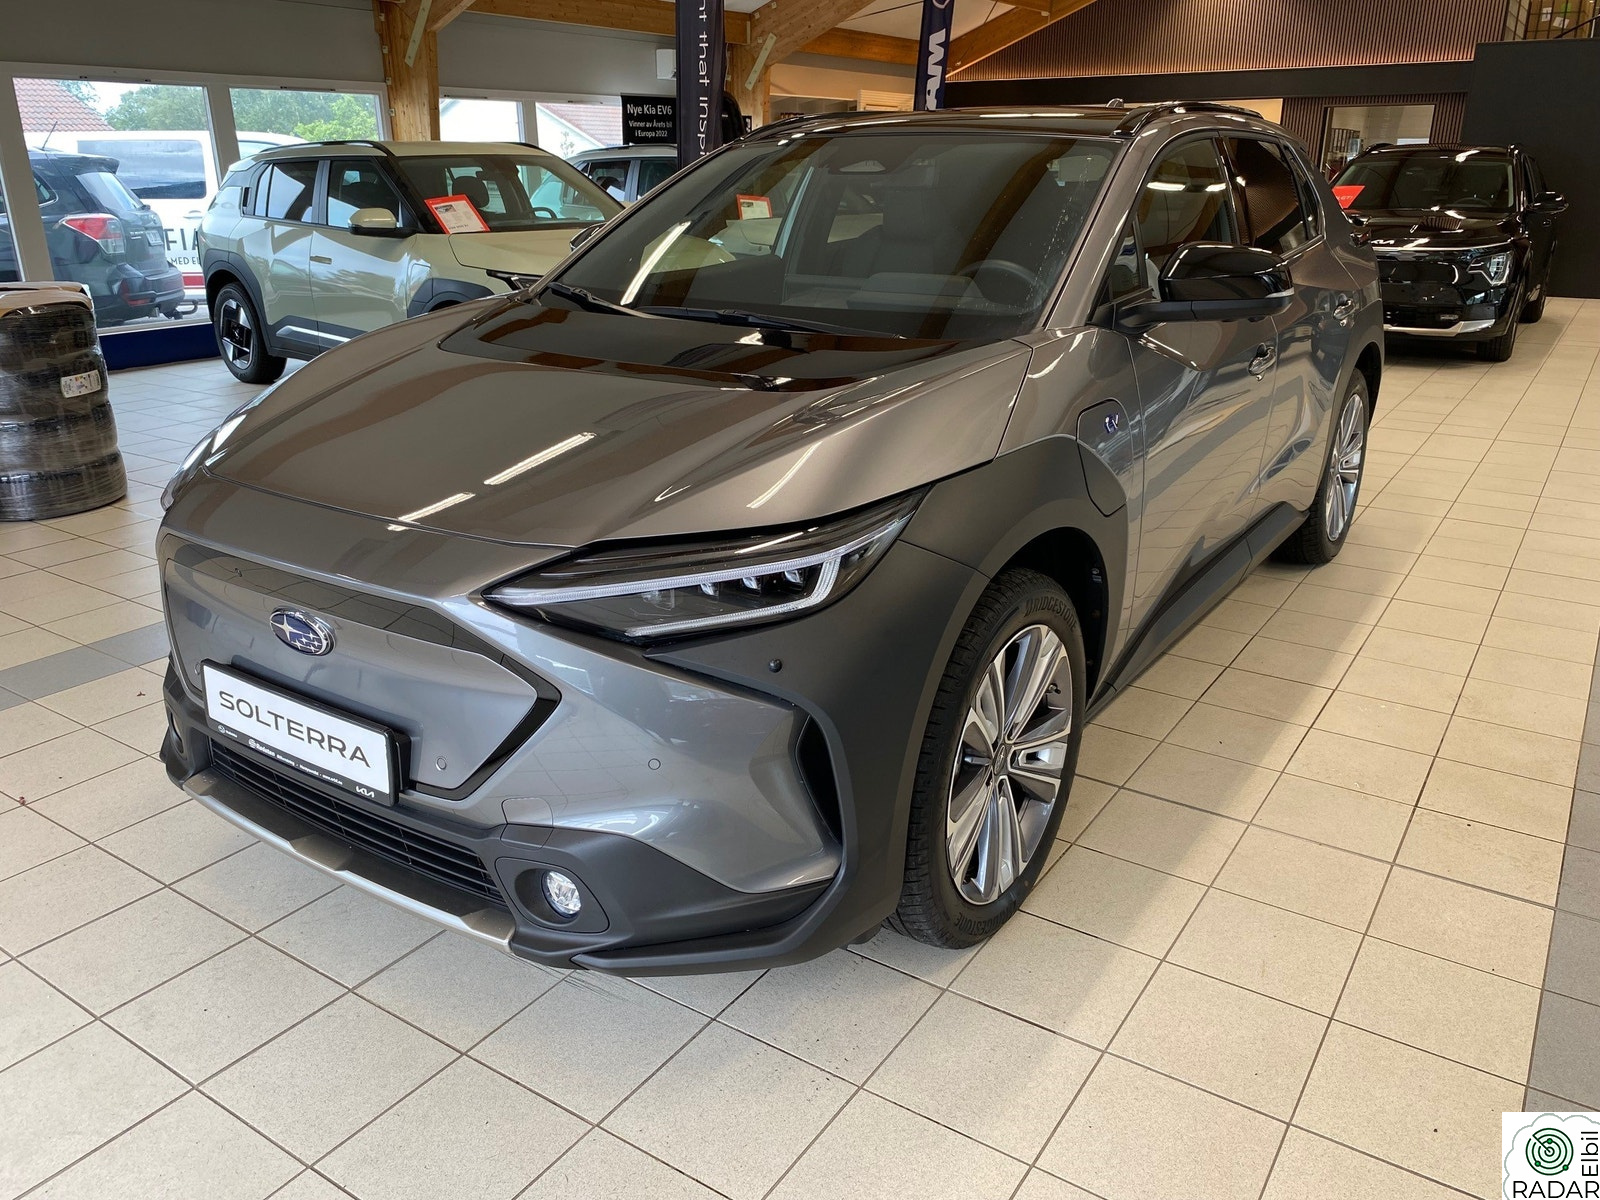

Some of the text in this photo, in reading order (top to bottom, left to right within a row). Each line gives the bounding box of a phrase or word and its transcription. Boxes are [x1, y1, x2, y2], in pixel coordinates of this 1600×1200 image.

[699, 31, 710, 86] that
[627, 103, 672, 116] Nye Kia EV6
[653, 119, 666, 128] Årets
[638, 130, 655, 138] Europa
[171, 256, 190, 265] MED
[219, 690, 371, 768] SOLTERRA
[355, 785, 375, 798] KIA
